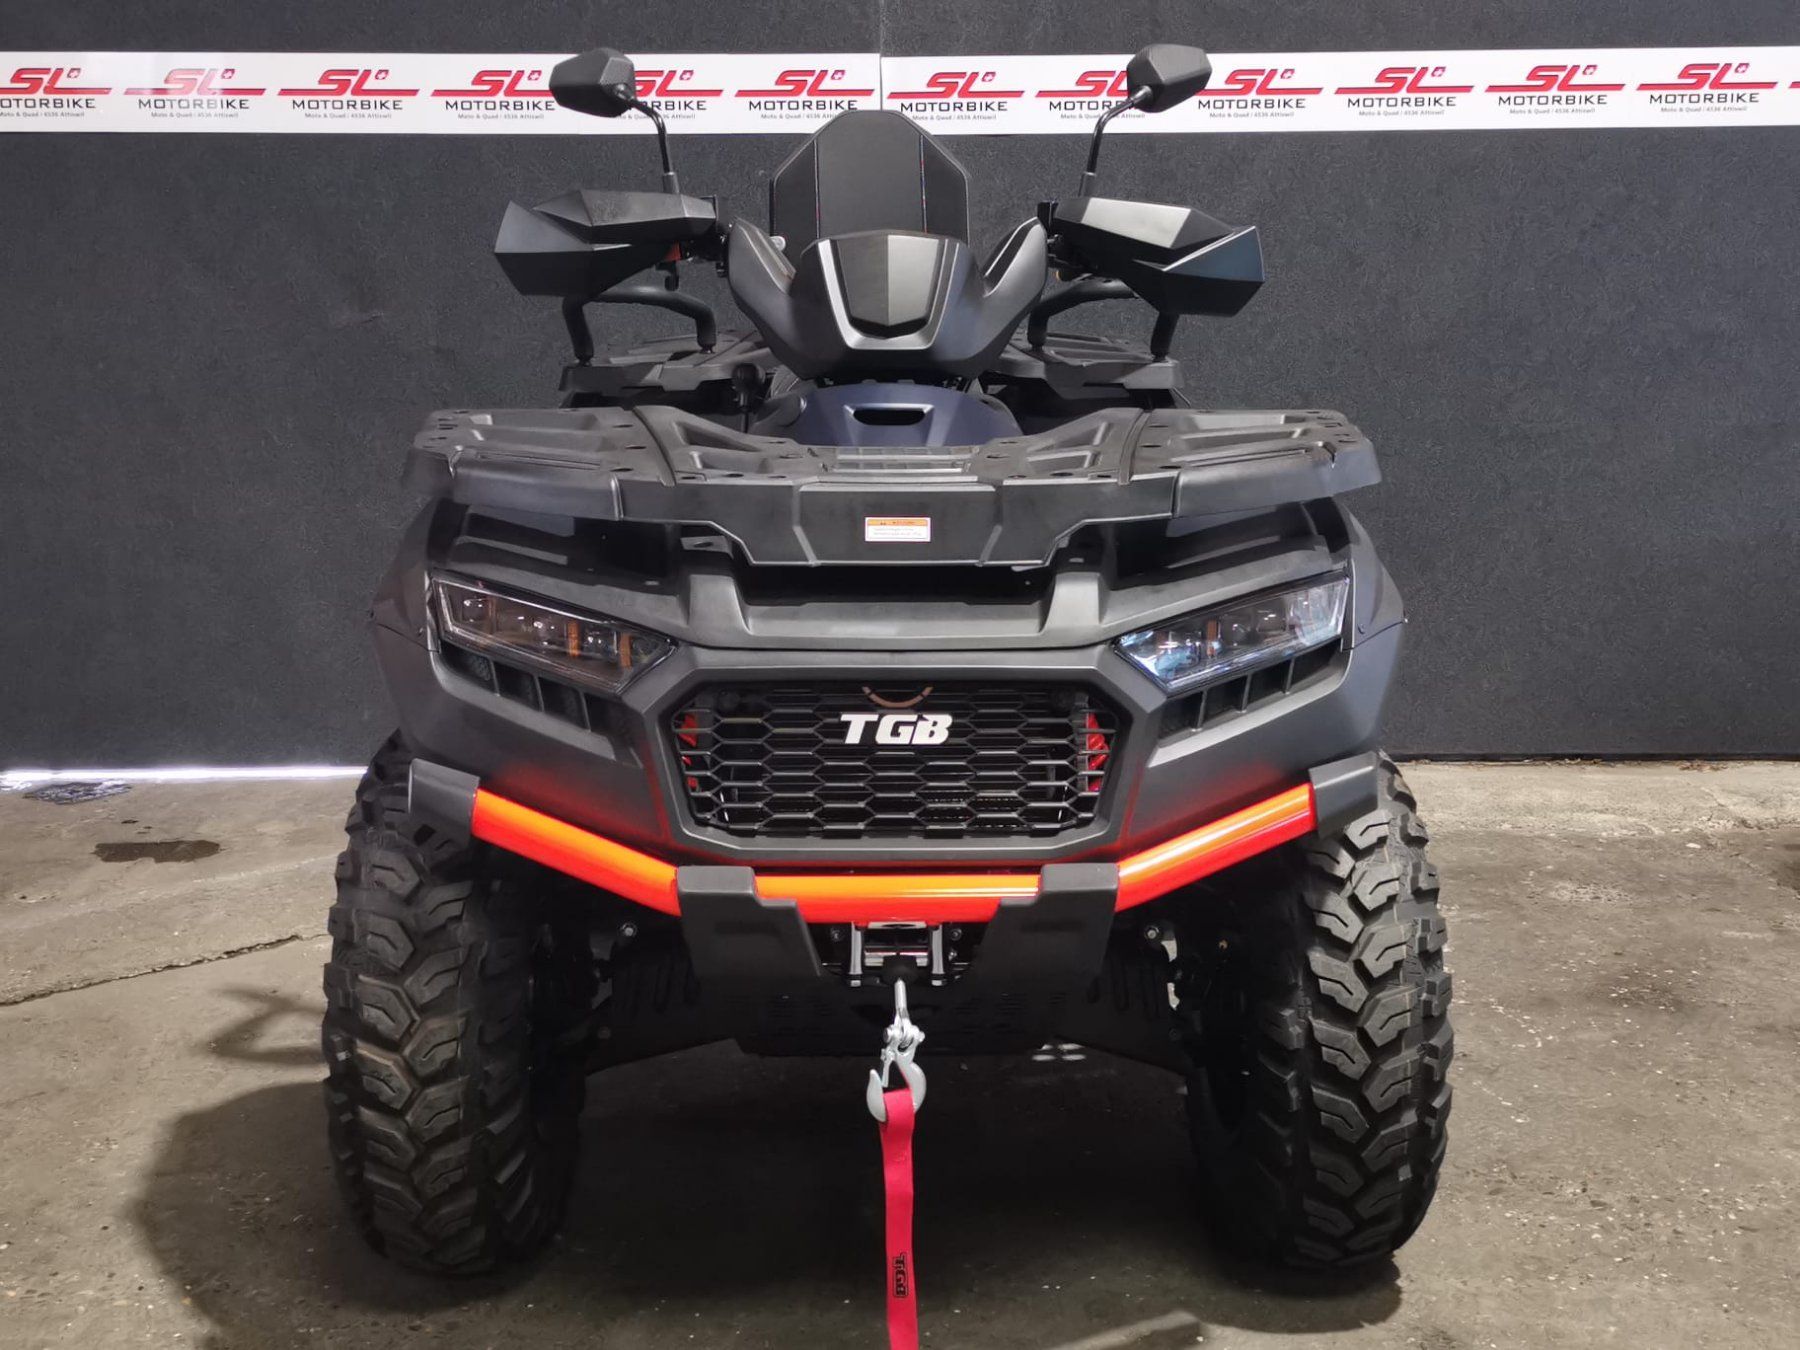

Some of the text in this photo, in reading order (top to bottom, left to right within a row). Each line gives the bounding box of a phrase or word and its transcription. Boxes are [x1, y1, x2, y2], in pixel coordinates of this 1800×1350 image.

[0, 98, 96, 109] OTORBIKE
[138, 98, 250, 109] MOTORBIKE
[1198, 98, 1306, 110] MOTORBIKE
[1347, 96, 1457, 108] MOTORBIKE
[1498, 94, 1608, 106] MOTORBIKE
[1649, 92, 1760, 104] MOTORBIKE
[292, 99, 403, 110] MOTORBIKE
[445, 100, 556, 111] MOTORBIKE
[749, 100, 858, 111] MOTORBIKE
[900, 101, 1008, 113] MOTORBIKE
[840, 713, 953, 745] TGB
